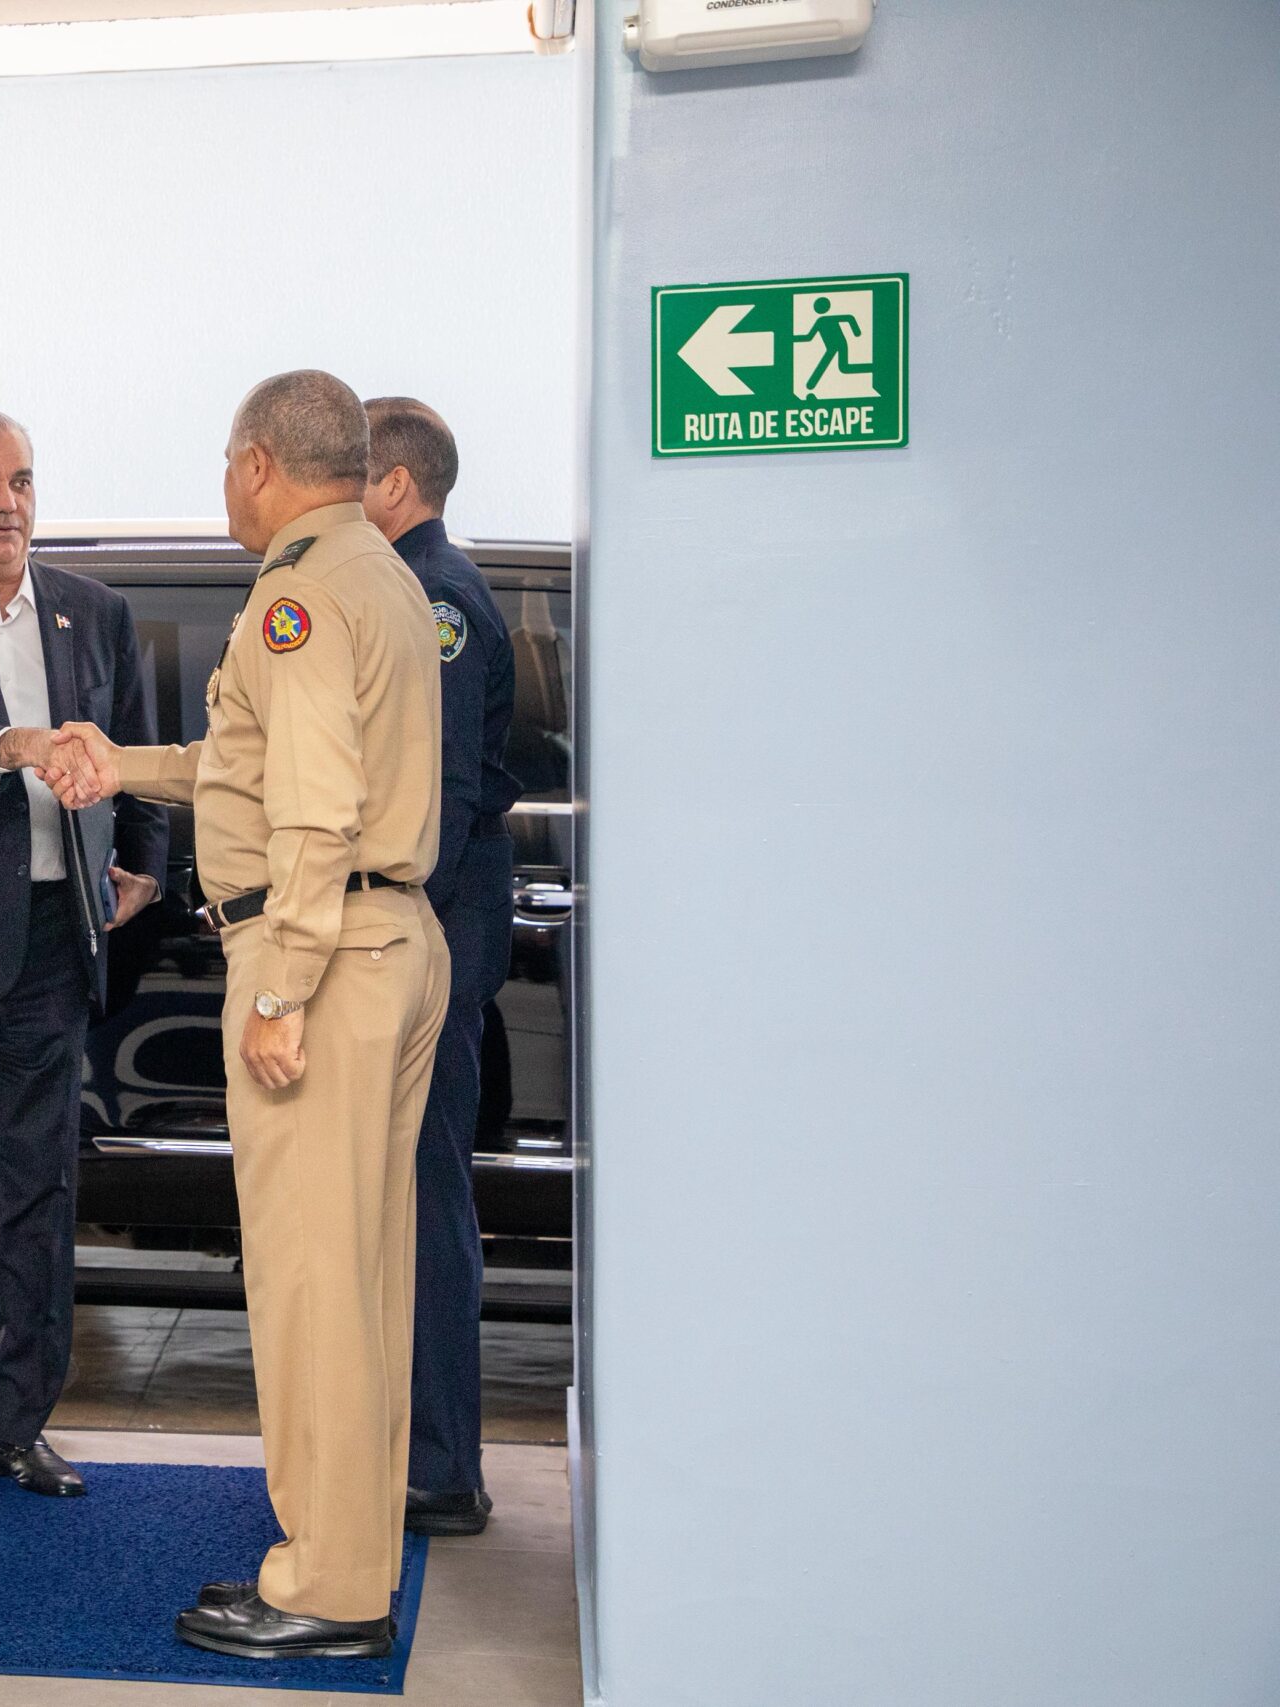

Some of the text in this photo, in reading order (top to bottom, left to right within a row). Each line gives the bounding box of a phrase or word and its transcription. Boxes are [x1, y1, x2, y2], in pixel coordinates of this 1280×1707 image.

[684, 406, 874, 441] RUTA DE ESCAPE
